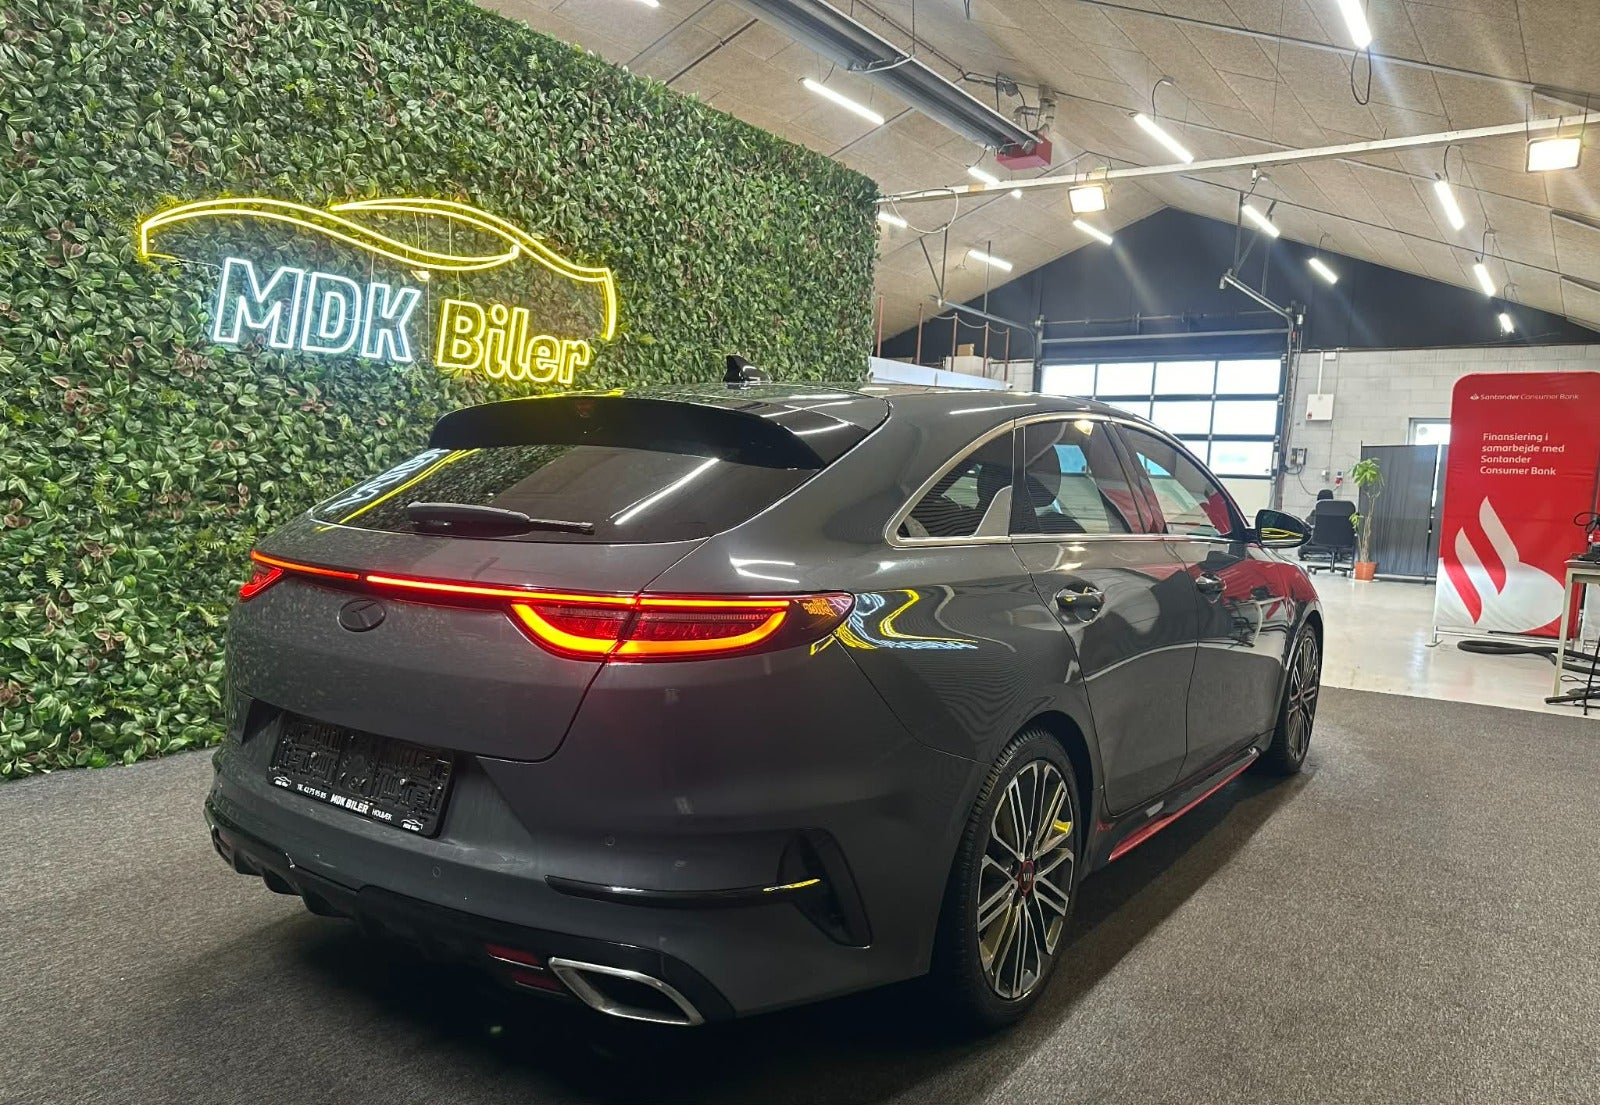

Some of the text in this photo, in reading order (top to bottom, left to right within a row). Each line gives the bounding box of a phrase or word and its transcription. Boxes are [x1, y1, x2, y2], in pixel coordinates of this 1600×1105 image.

[213, 256, 591, 384] MDK Biler
[1483, 433, 1543, 442] Finansiering
[1482, 444, 1565, 453] samarbejde med
[1480, 455, 1532, 464] Santander
[1480, 466, 1556, 475] Consumer Bank
[330, 793, 346, 806] MDK
[345, 799, 369, 814] BILER
